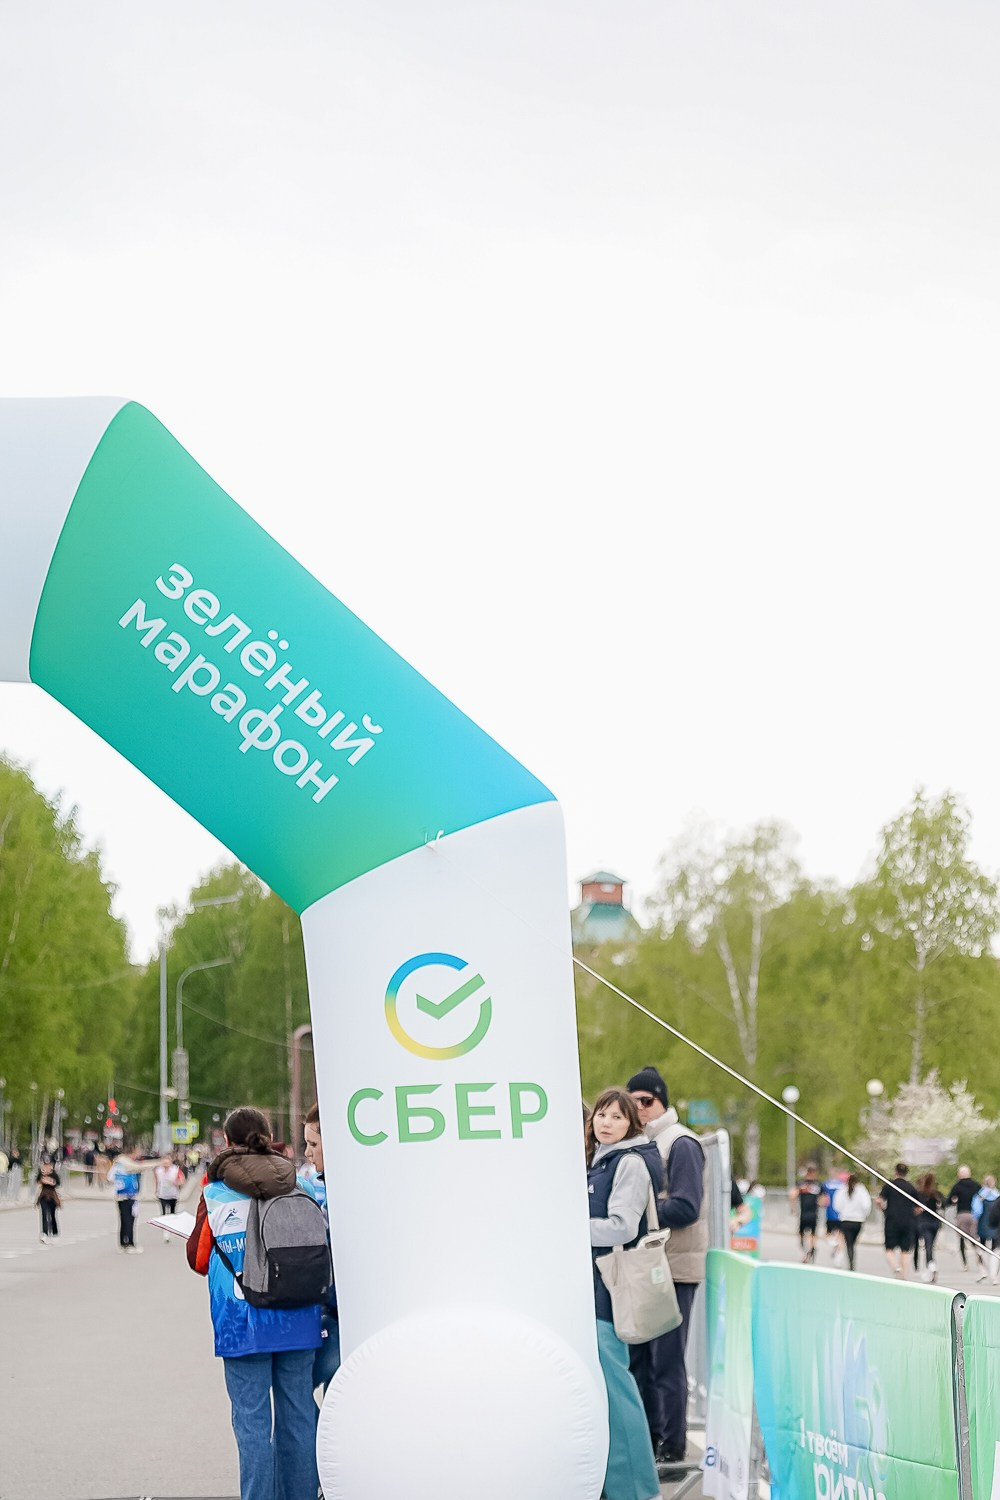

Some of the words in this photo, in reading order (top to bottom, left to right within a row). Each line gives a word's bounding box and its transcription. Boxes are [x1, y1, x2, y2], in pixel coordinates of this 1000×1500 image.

[117, 597, 340, 804] марафон
[155, 562, 384, 767] зелёный
[347, 1082, 549, 1147] СБЕР
